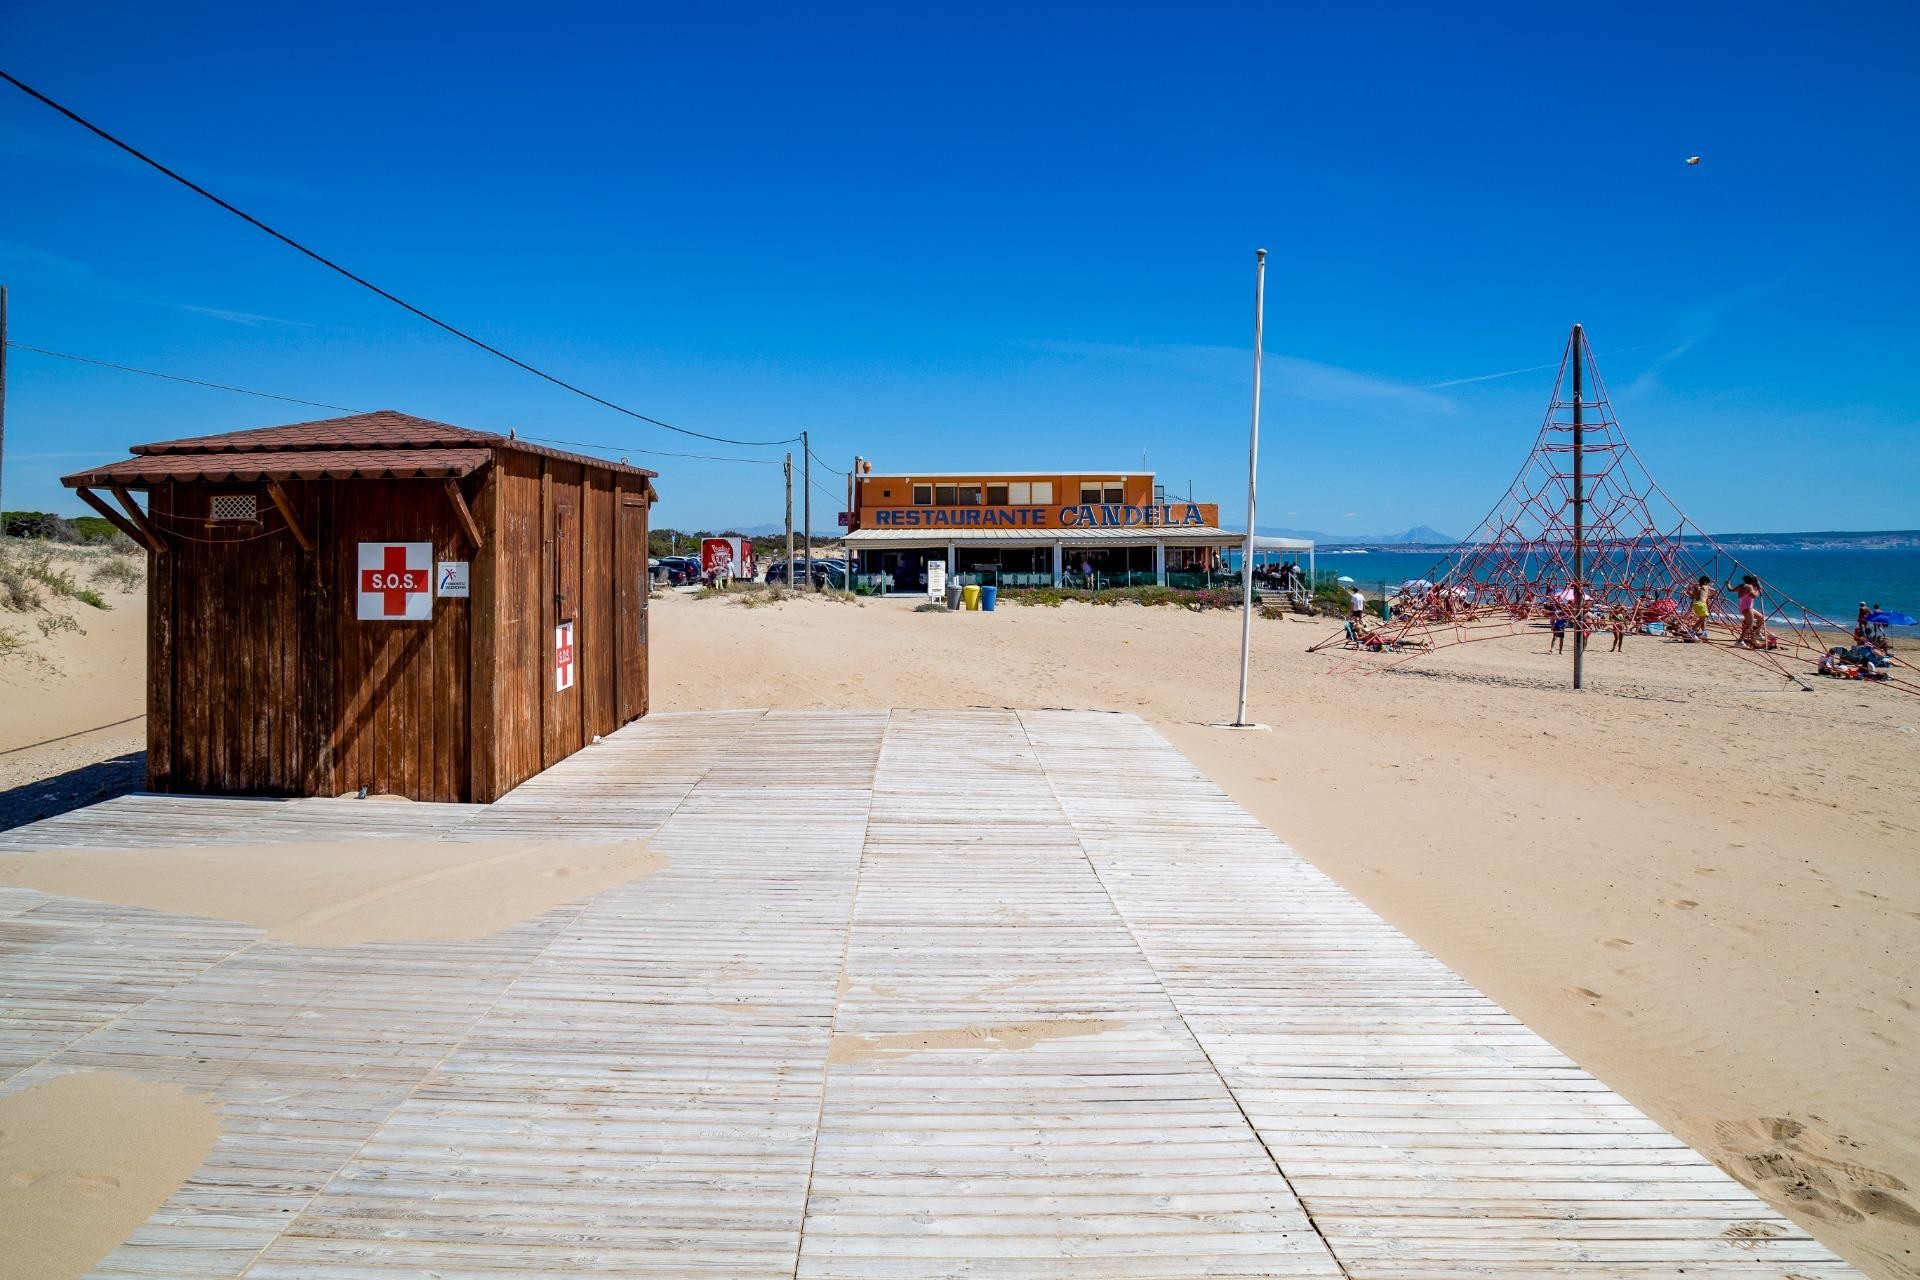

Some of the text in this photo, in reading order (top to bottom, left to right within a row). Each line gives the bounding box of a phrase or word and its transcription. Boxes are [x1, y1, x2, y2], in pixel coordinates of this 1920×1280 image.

[876, 503, 1205, 527] RESTAURANTE CANDELA
[372, 573, 418, 589] S.O.S.
